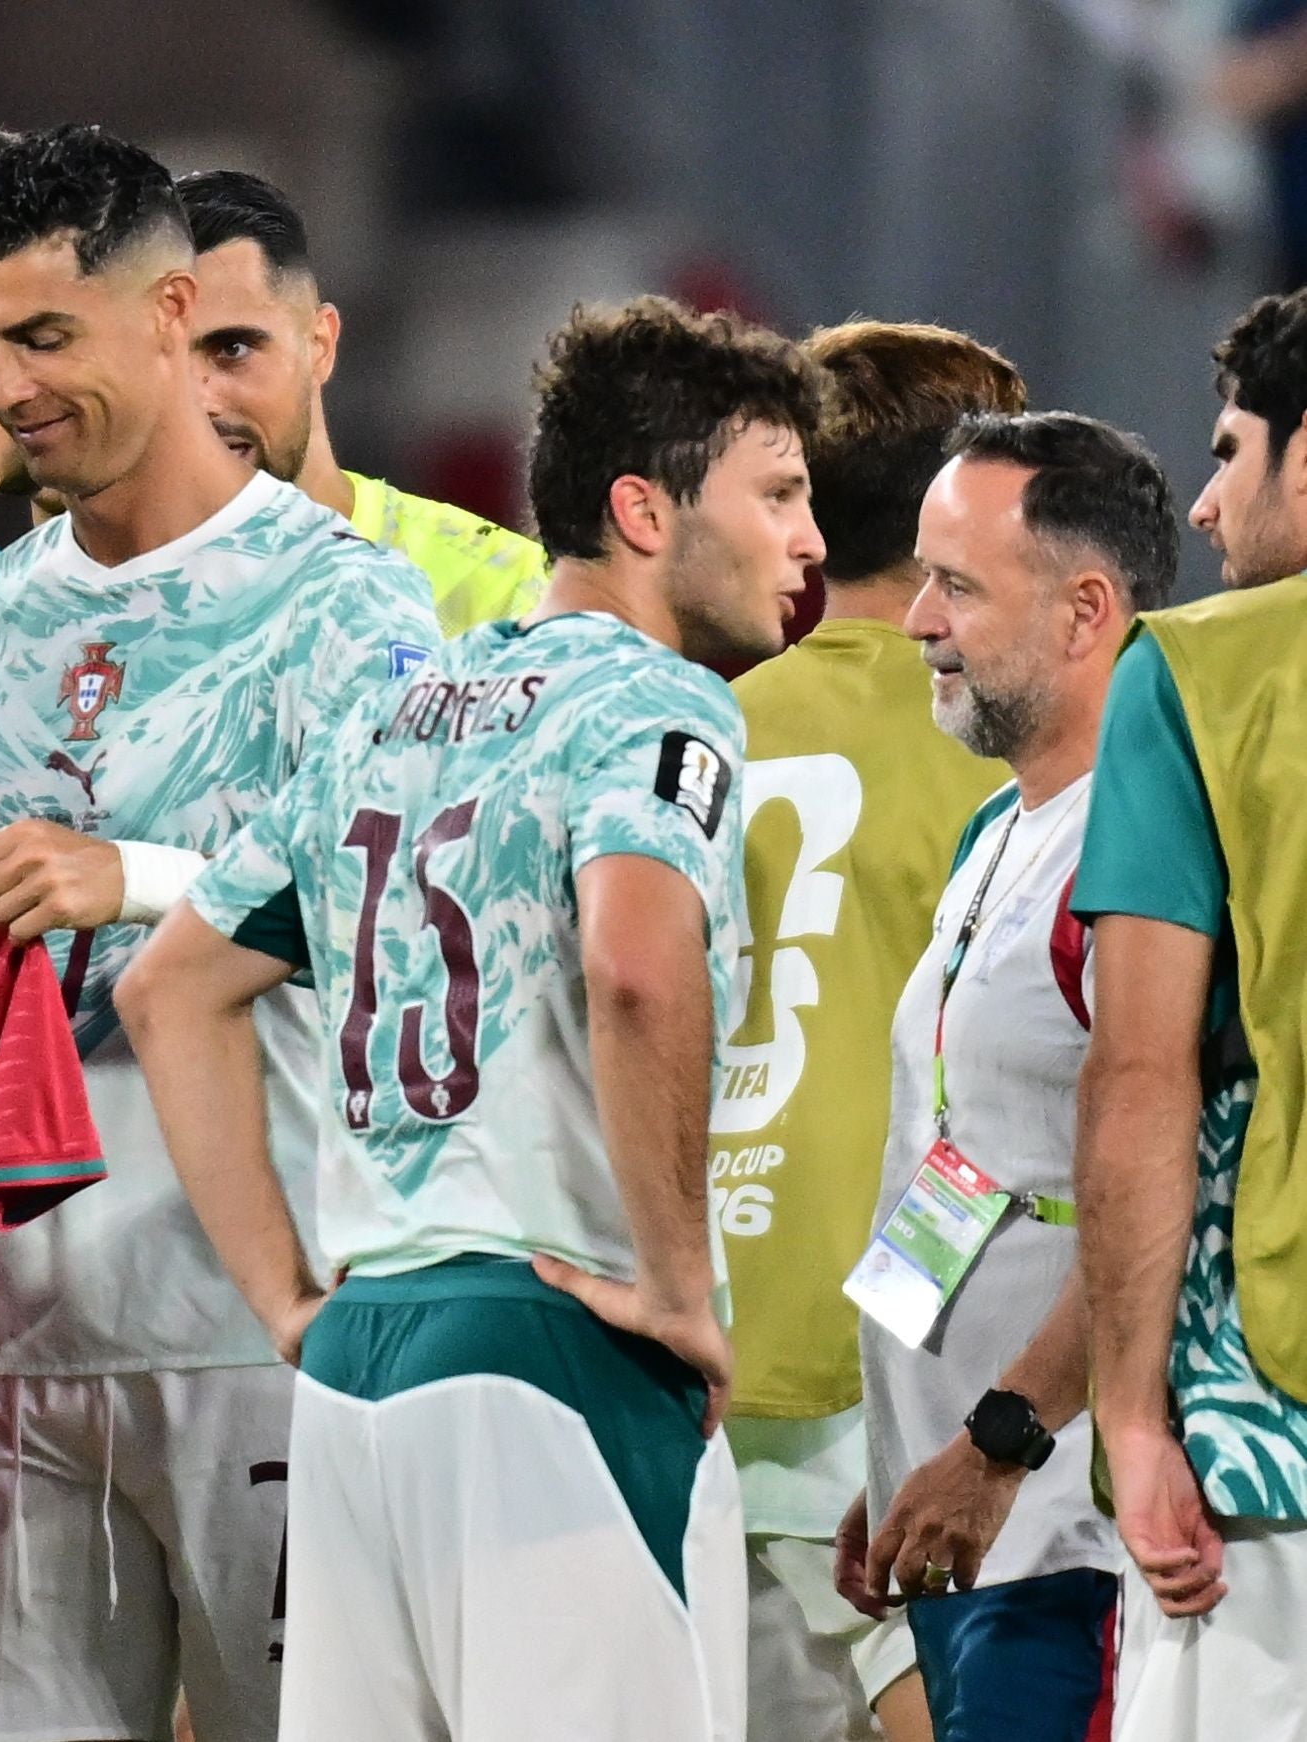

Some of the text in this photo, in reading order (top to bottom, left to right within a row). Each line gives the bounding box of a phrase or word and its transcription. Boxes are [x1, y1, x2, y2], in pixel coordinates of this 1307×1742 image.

[341, 796, 482, 1131] 15
[723, 1063, 770, 1100] IFA
[730, 1144, 786, 1178] CUP
